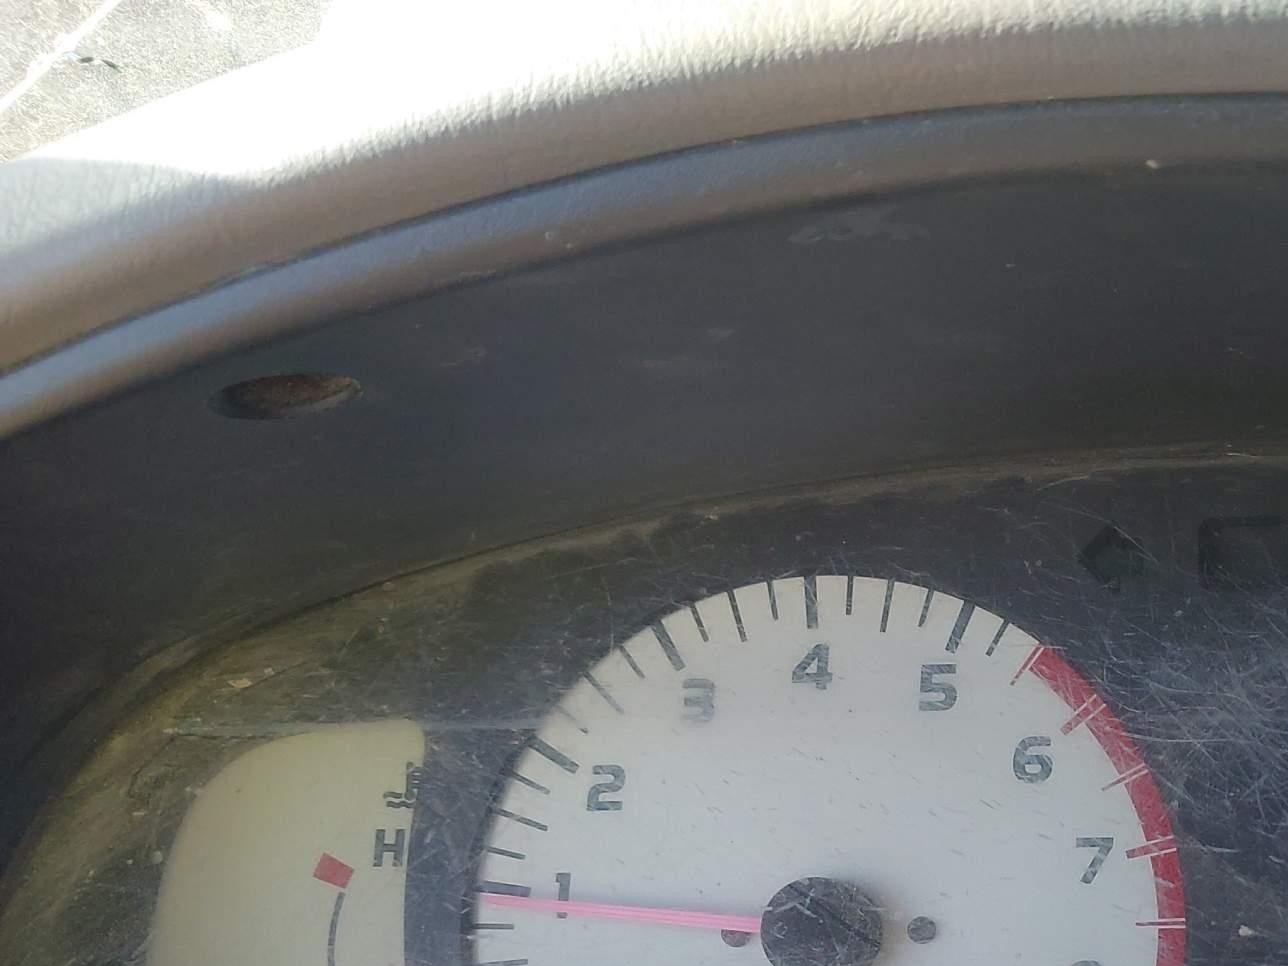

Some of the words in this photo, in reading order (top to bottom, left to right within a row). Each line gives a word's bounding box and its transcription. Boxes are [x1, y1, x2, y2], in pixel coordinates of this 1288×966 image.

[792, 642, 833, 690] 4
[918, 663, 958, 712] 5
[681, 677, 716, 722] 3
[1012, 735, 1053, 784] 6
[586, 764, 626, 811] 2
[373, 828, 405, 867] H
[1076, 837, 1114, 884] 7
[555, 872, 572, 919] 1
